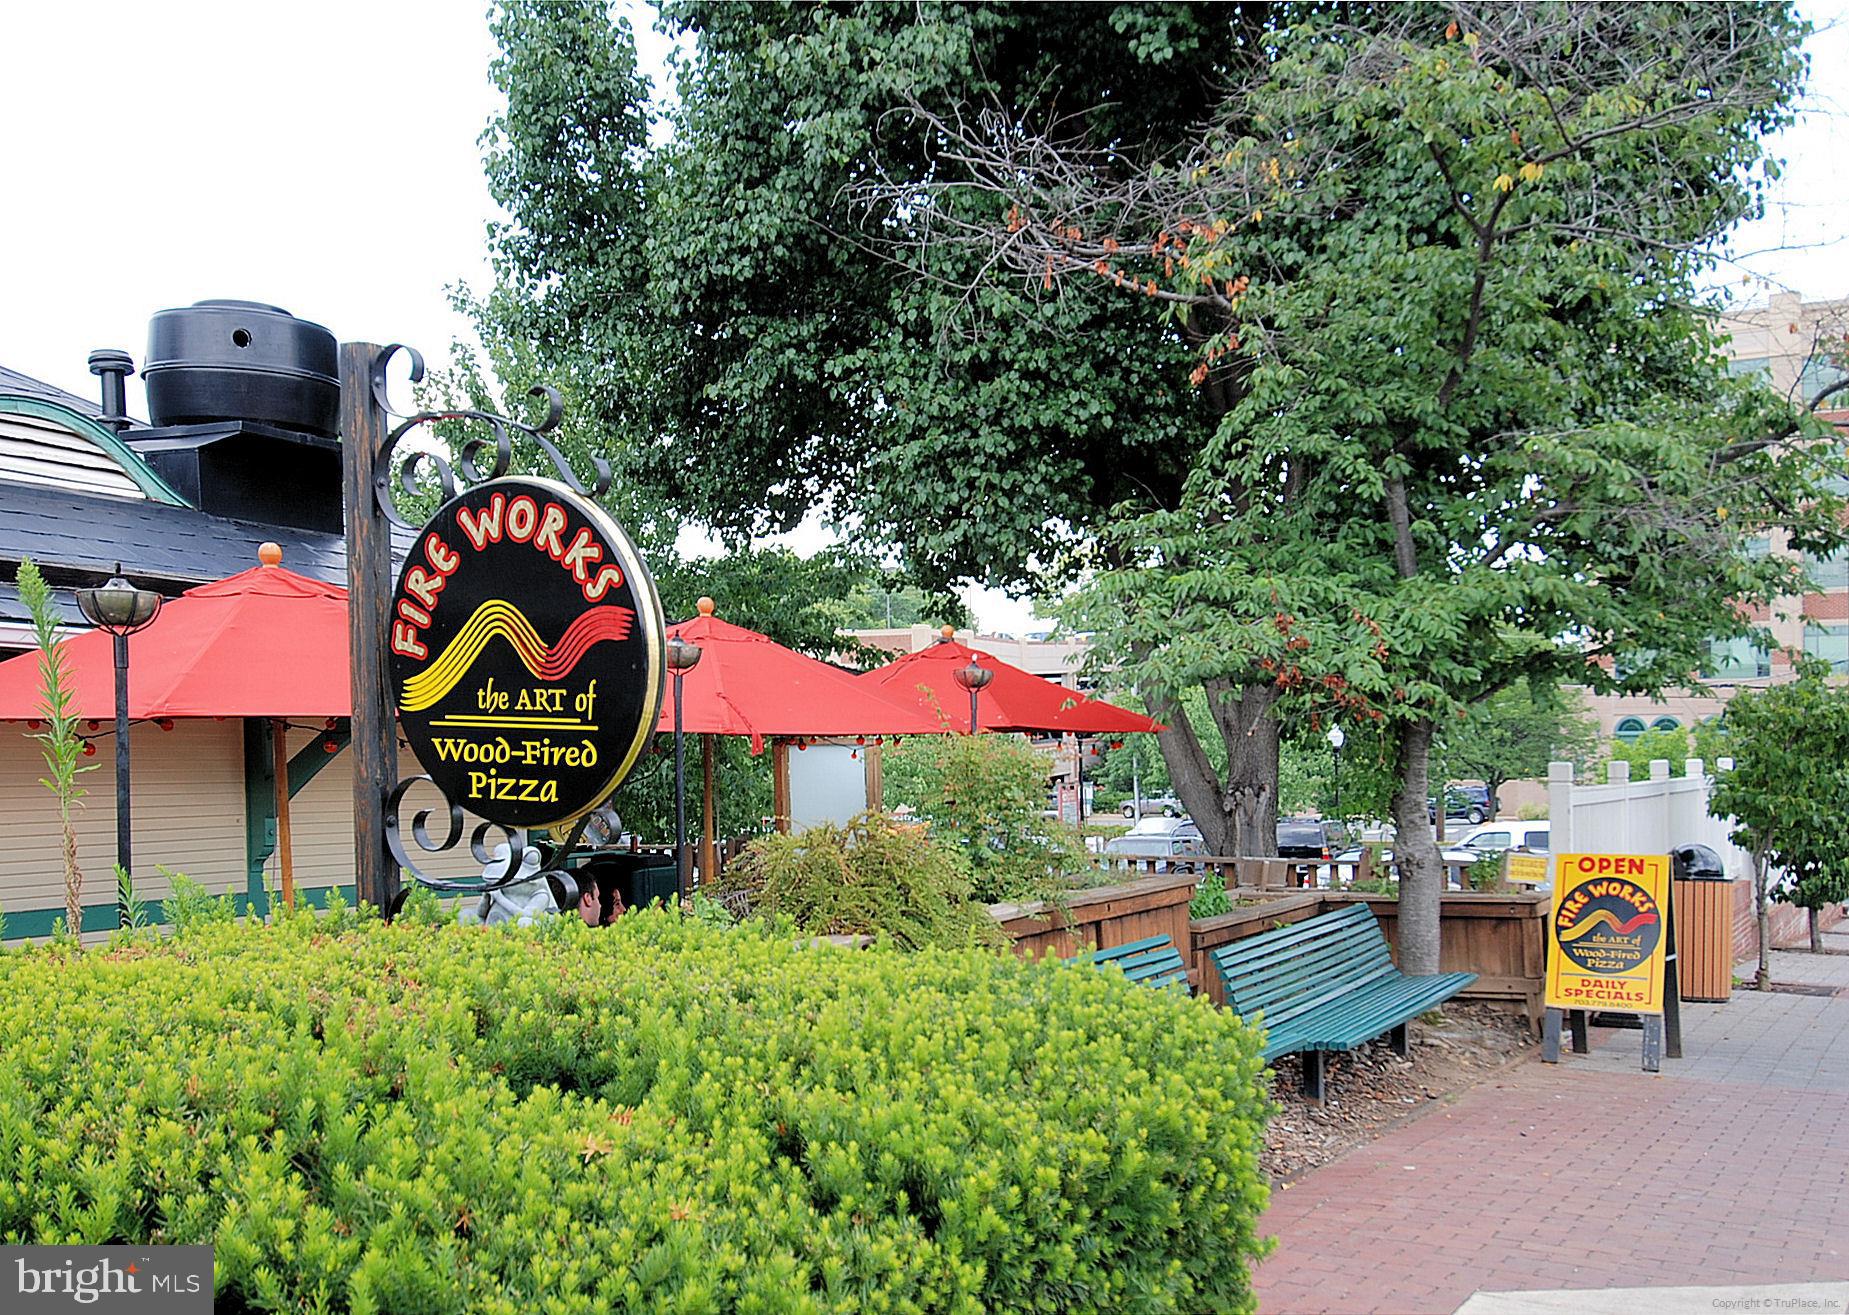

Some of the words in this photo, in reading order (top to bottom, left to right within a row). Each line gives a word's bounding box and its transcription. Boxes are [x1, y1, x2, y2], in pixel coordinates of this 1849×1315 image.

[391, 532, 461, 660] FIRE
[456, 492, 624, 600] WORKS
[477, 677, 509, 714] the
[514, 688, 567, 712] ART
[575, 679, 597, 721] of
[431, 736, 599, 767] Wood-Fired
[468, 768, 559, 803] Pizza
[1578, 856, 1645, 875] OPEN
[1557, 891, 1590, 928] FIRE
[1587, 880, 1656, 913] WORKS
[1592, 932, 1607, 943] the
[1608, 936, 1630, 944] ART
[1631, 934, 1642, 946] of
[1572, 948, 1641, 960] Wood-Fired
[1586, 959, 1625, 969] Pizza
[1580, 978, 1628, 989] DAILY
[1564, 988, 1644, 1002] SPECIALS
